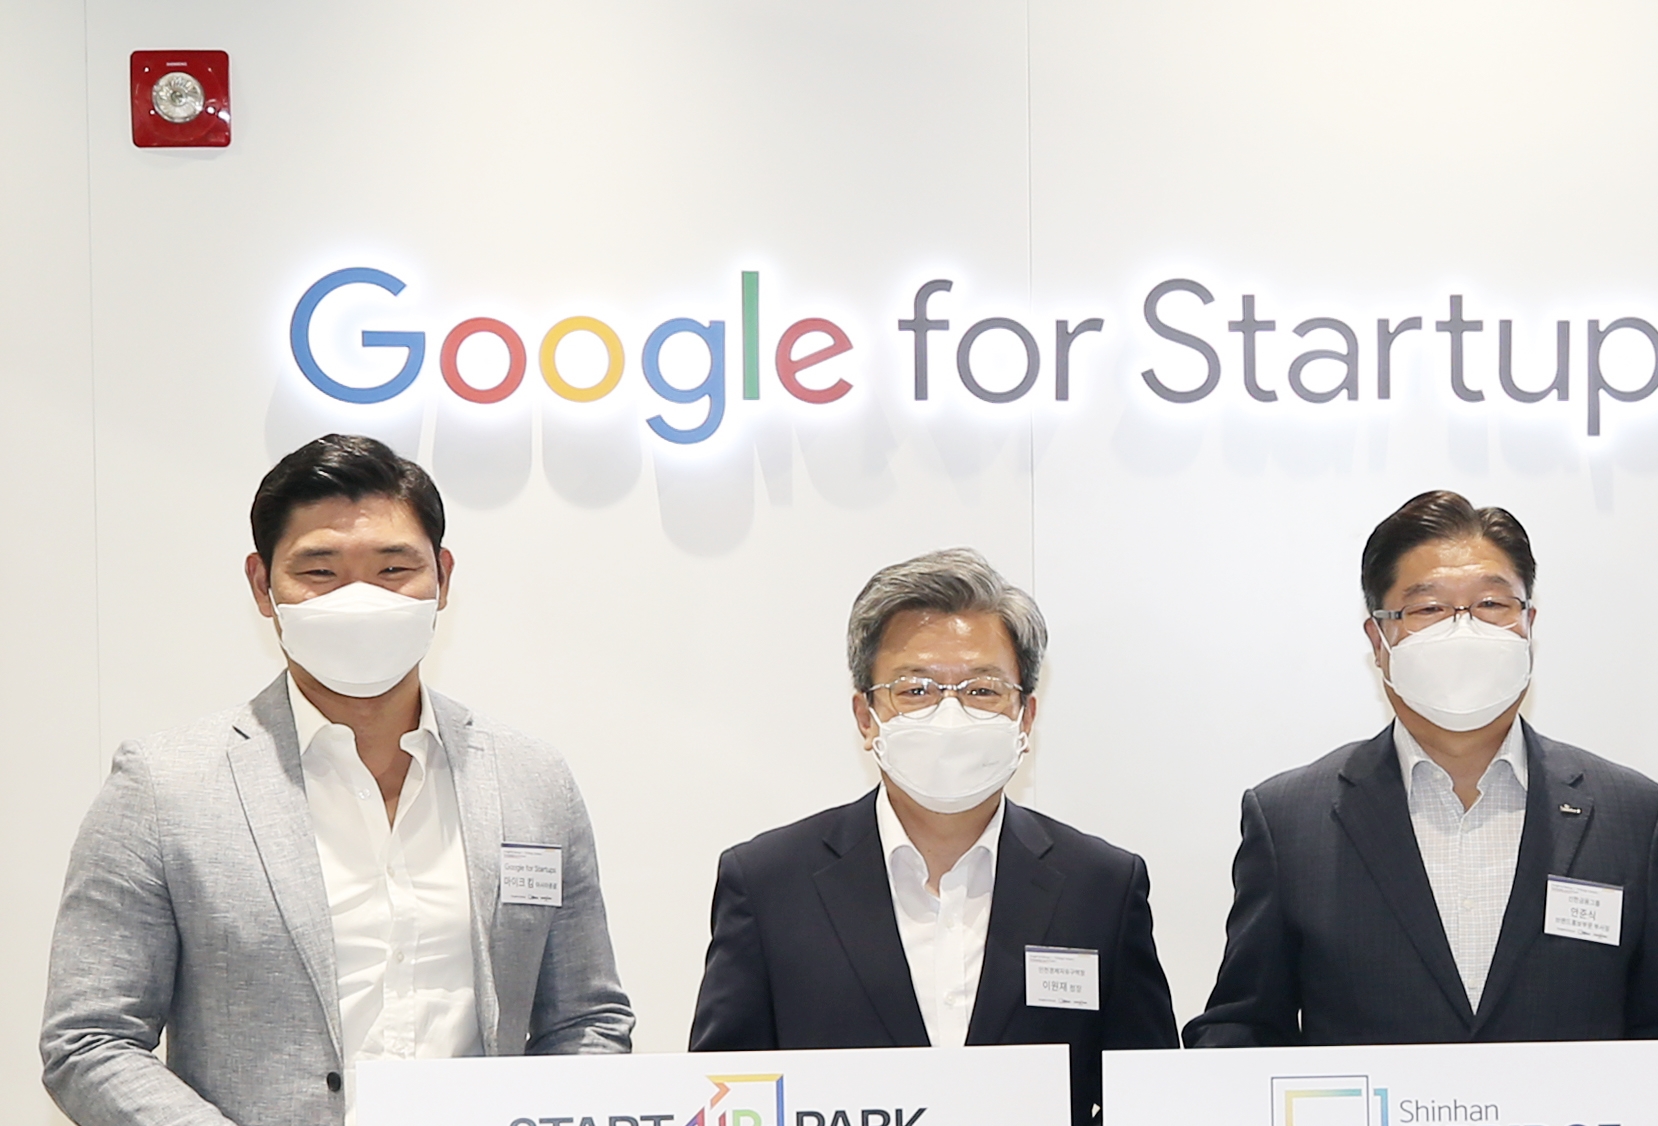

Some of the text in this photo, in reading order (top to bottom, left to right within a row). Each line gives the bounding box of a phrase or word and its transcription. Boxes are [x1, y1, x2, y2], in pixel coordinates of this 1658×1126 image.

[289, 266, 854, 444] Google
[897, 278, 1105, 404] for
[504, 863, 556, 875] Google for Startups
[504, 876, 525, 888] 마이크
[1042, 980, 1067, 992] 이원재
[1400, 1100, 1499, 1123] Shinhan
